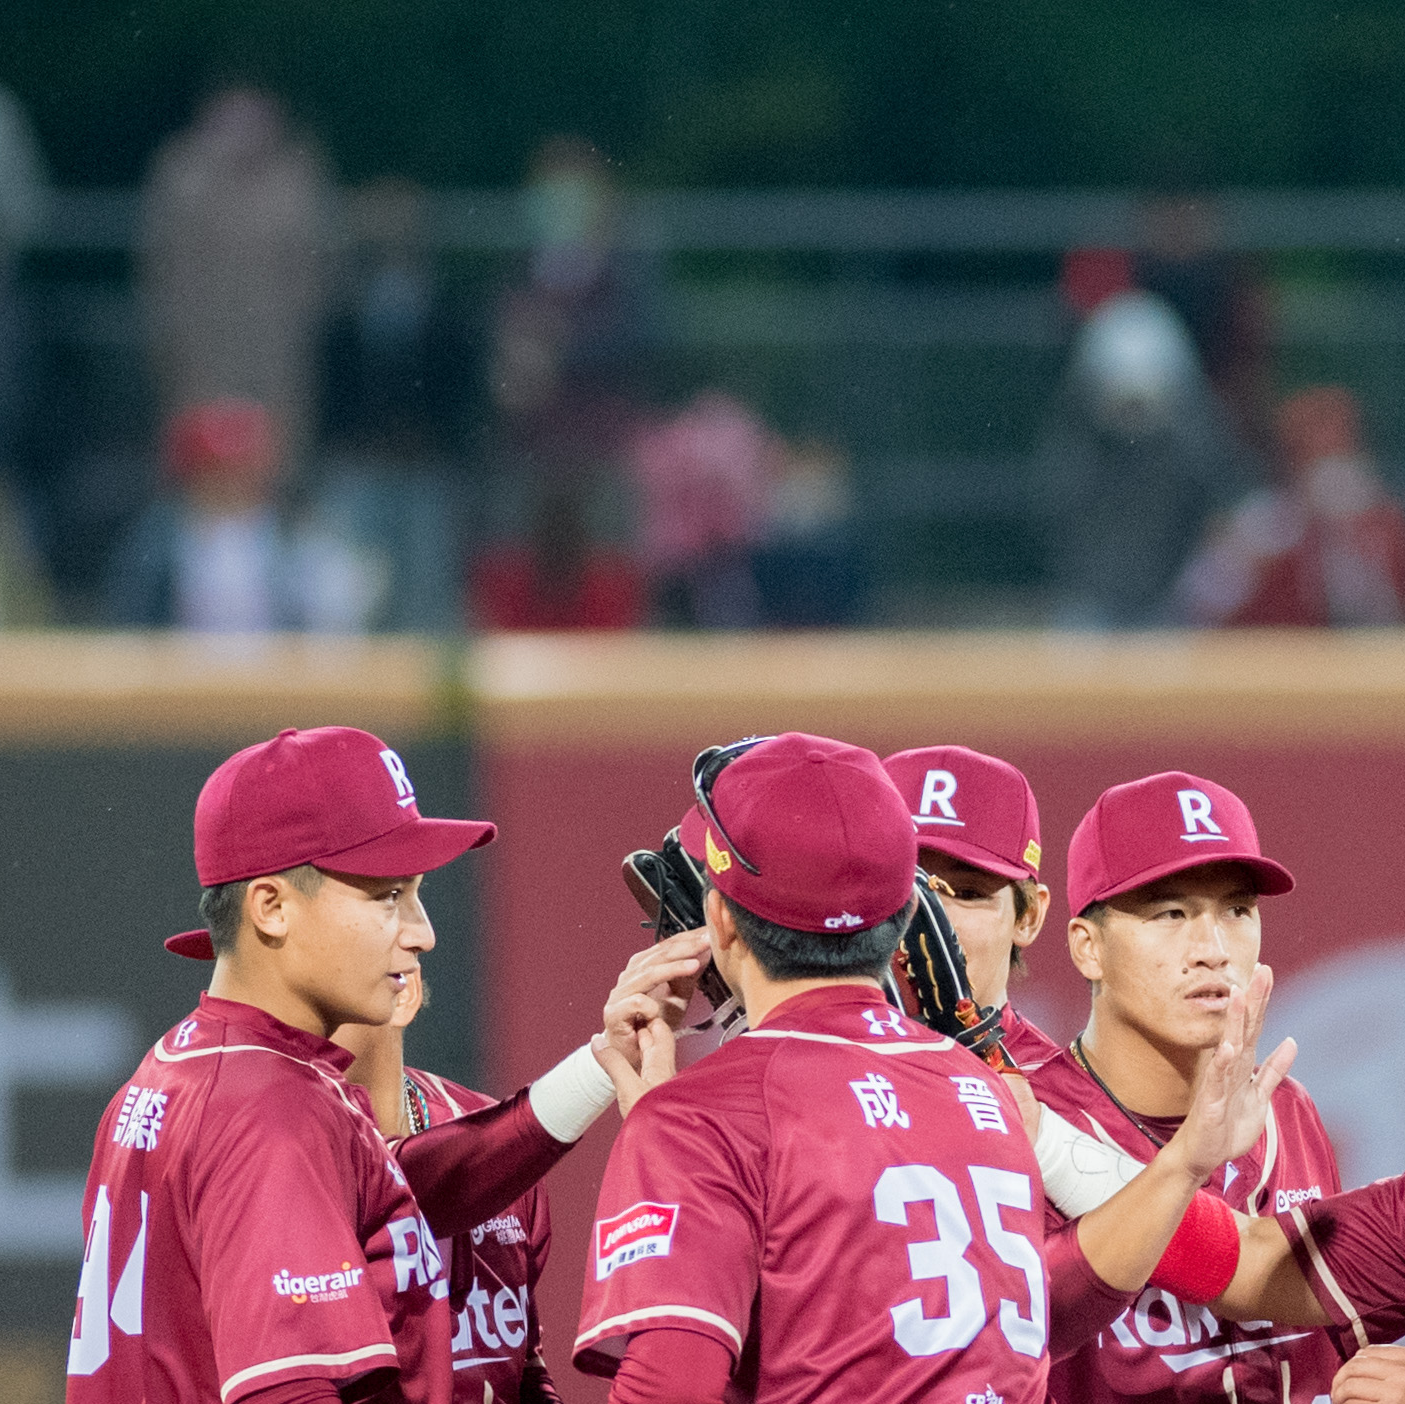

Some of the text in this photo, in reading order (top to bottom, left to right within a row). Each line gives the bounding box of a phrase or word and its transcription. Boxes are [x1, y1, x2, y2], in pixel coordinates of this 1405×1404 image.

[379, 749, 415, 797] R
[919, 769, 958, 819] R
[1177, 789, 1223, 834] R
[272, 1261, 364, 1305] tigerair
[873, 1163, 1051, 1359] 35
